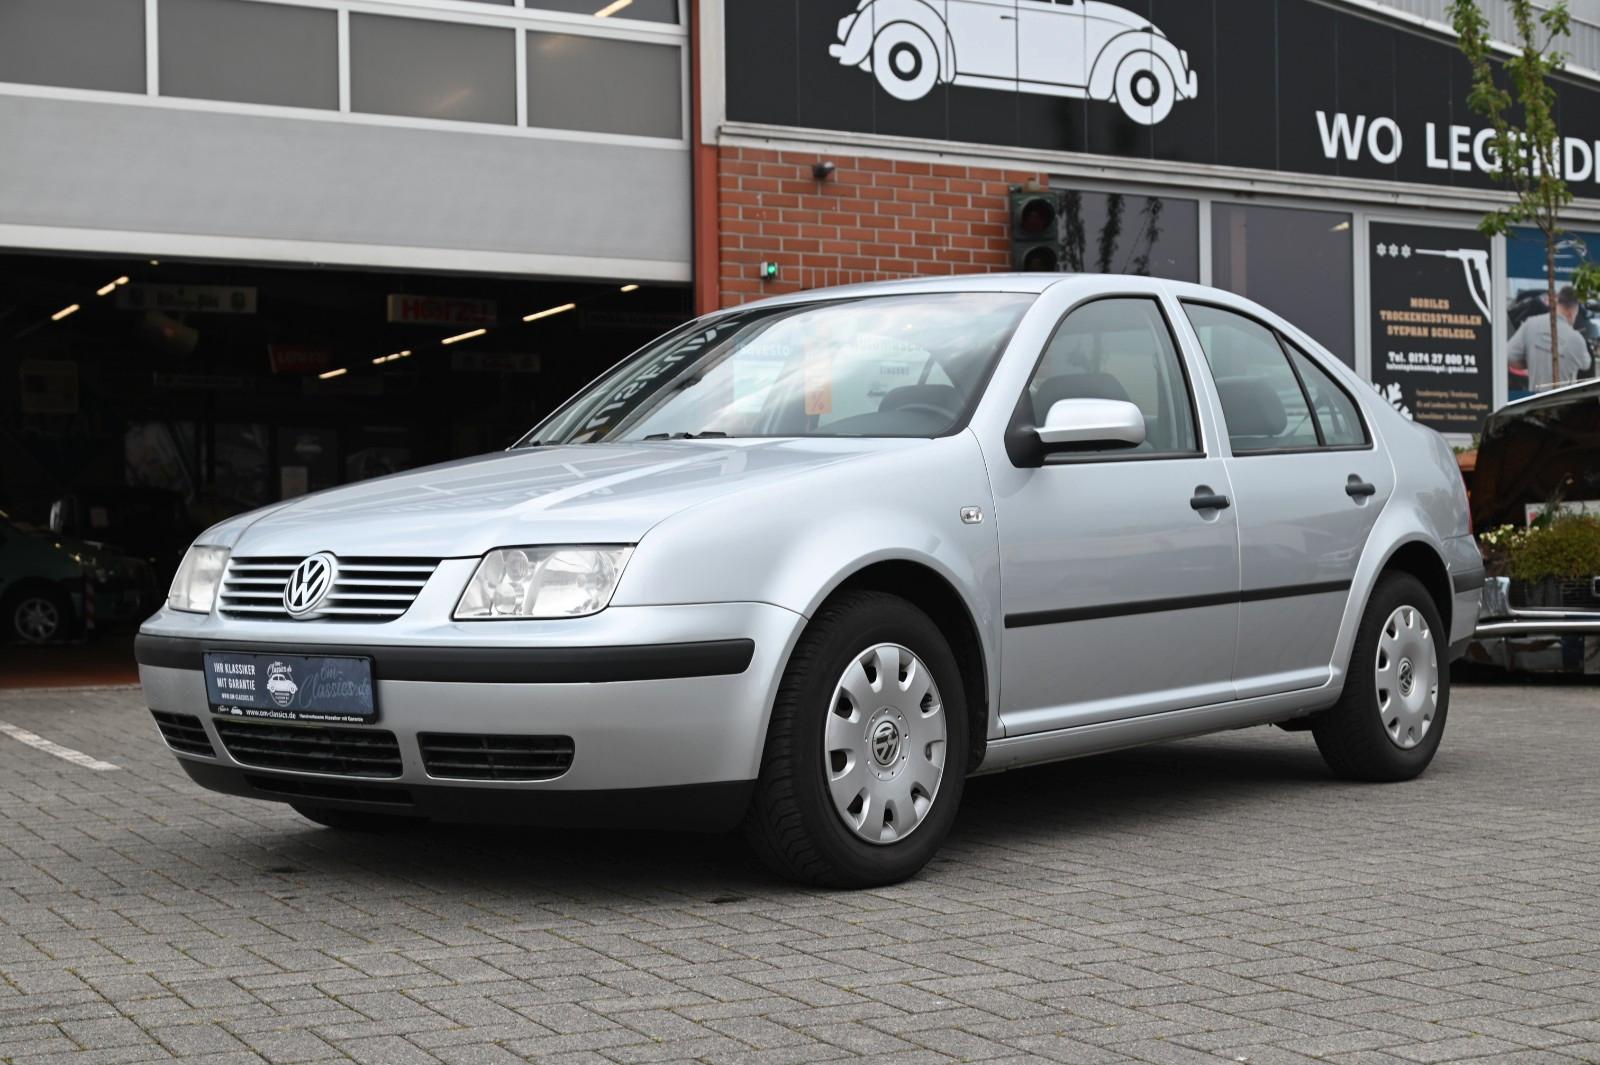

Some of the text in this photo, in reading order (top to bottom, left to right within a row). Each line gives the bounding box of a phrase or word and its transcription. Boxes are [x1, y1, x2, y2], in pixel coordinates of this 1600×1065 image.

[1315, 110, 1403, 165] WO
[1410, 297, 1449, 310] MOBILES
[1387, 325, 1476, 339] STEPHAN SCHLEGEL
[1388, 351, 1406, 362] Tel.
[1408, 352, 1430, 363] 0174
[1431, 353, 1443, 364] 37
[1464, 355, 1476, 365] 74
[286, 555, 331, 613] VW
[213, 662, 256, 676] IHR KLASSIKER
[217, 677, 256, 691] MIT GARANTIE
[246, 709, 296, 719] www.om-classics.de
